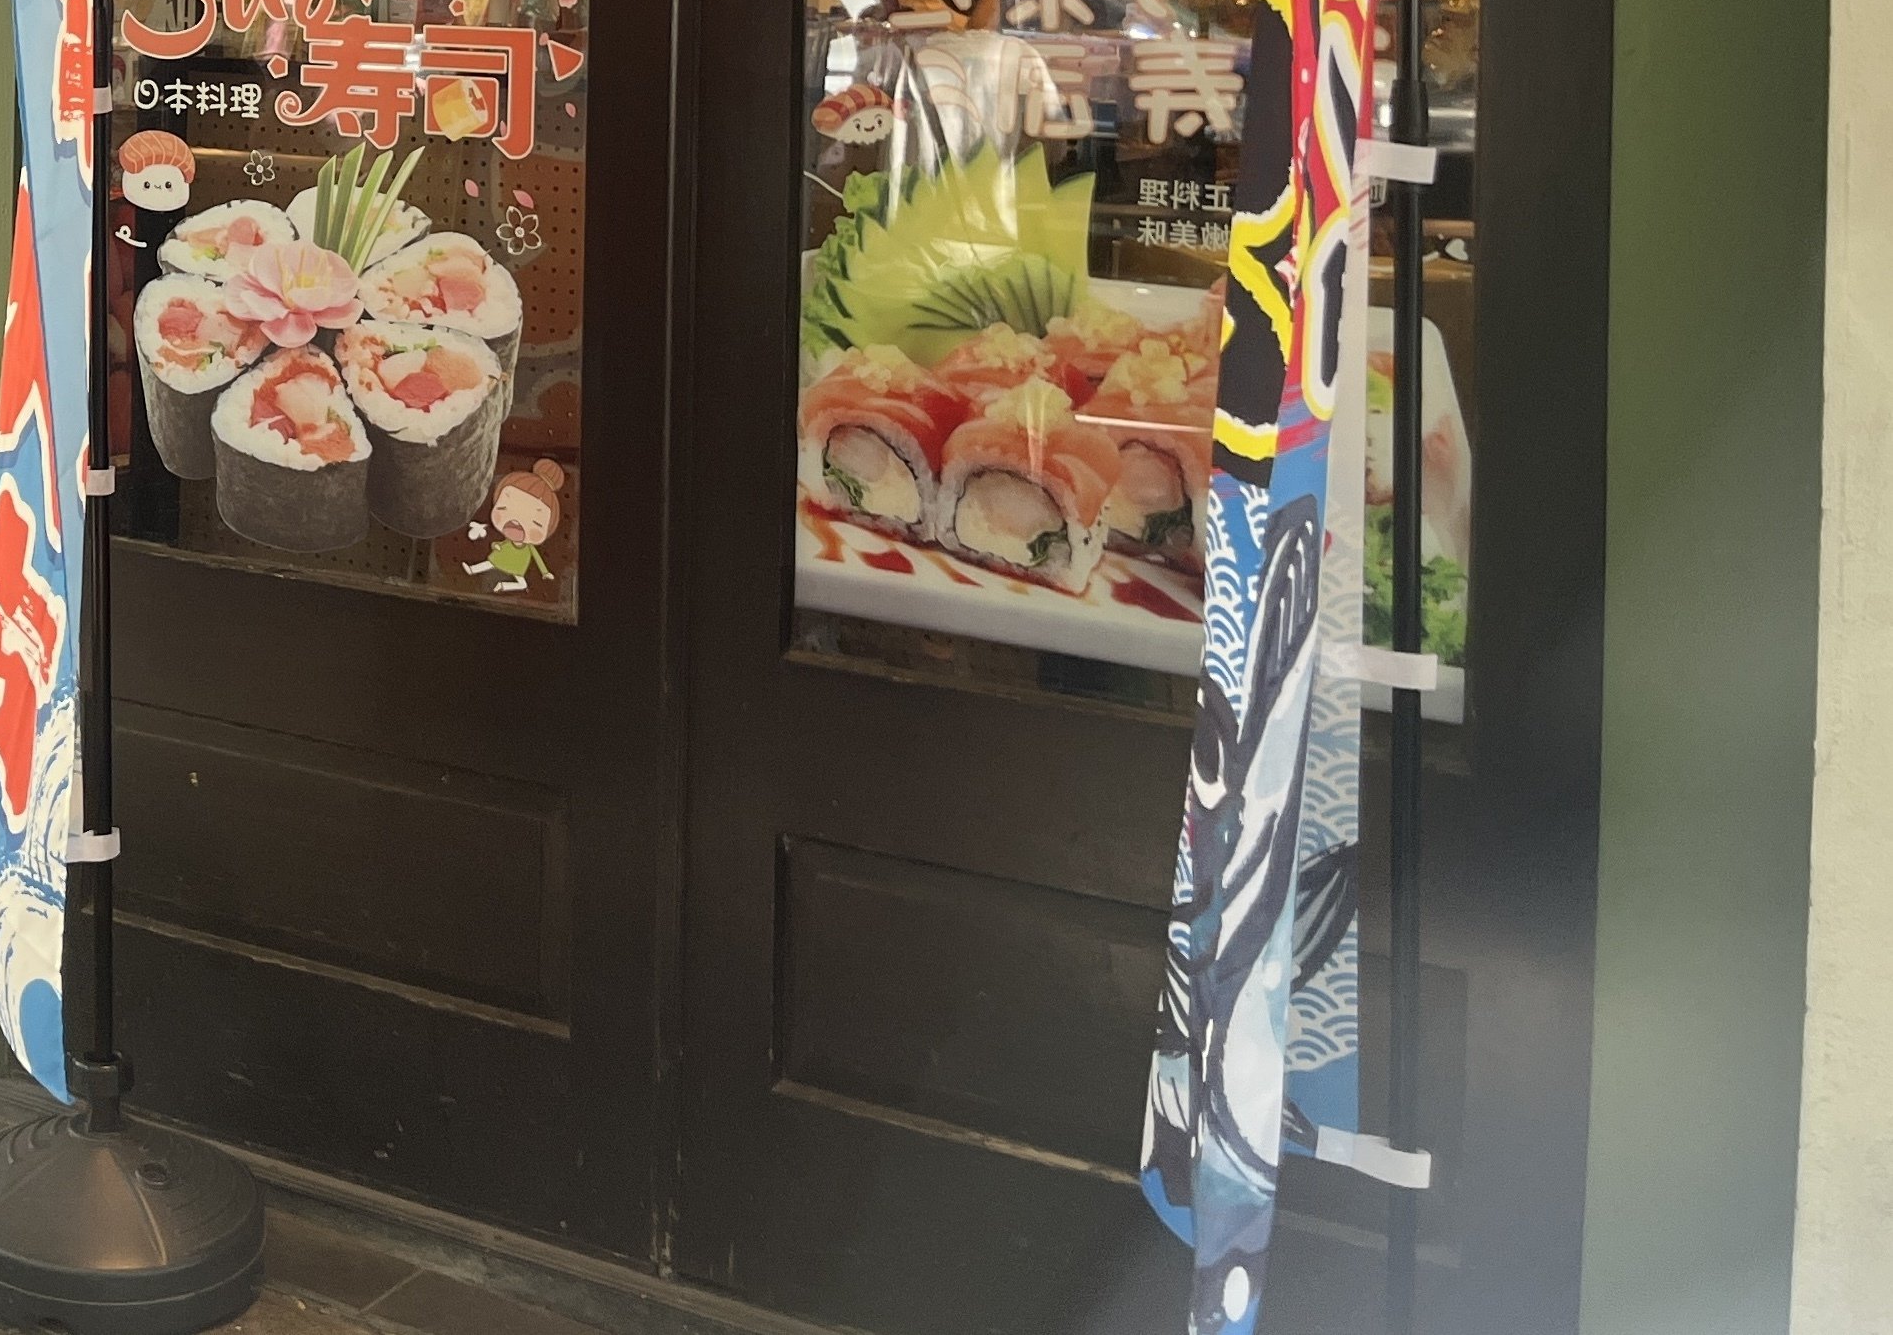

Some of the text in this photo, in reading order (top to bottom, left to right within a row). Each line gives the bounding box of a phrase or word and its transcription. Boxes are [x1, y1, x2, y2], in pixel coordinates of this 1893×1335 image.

[133, 78, 262, 119] 日本料理
[274, 13, 537, 160] 寿司
